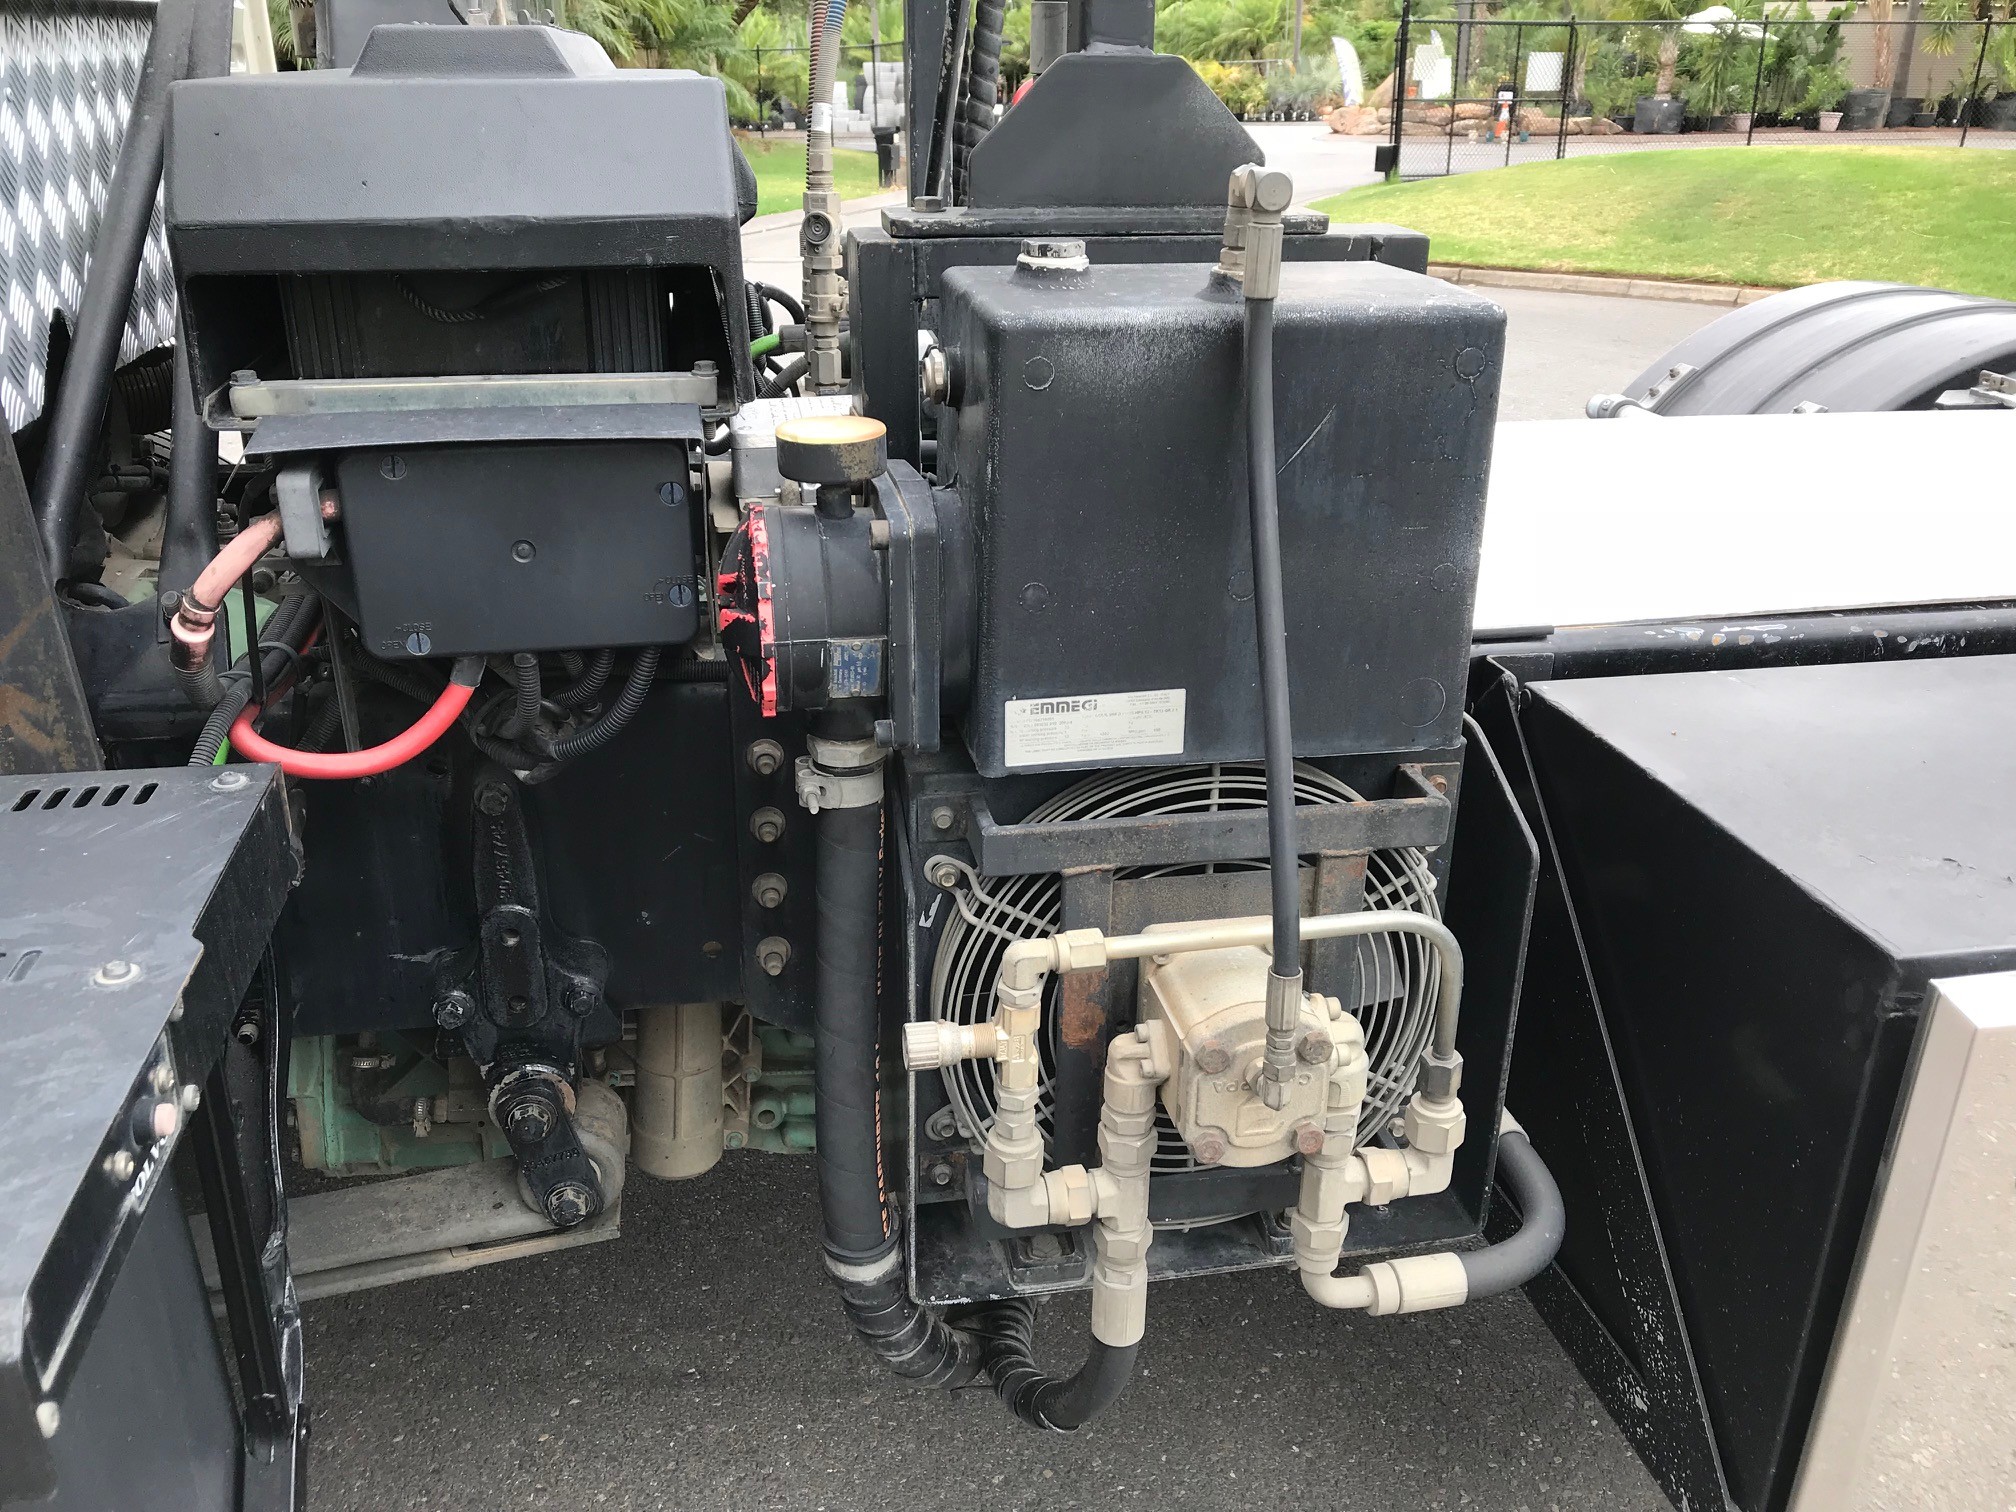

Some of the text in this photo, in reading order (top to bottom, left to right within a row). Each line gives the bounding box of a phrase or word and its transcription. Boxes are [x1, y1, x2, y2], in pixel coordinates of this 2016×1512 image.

[403, 621, 432, 632] CLOSE
[1212, 1073, 1312, 1095] CPPA
[131, 1136, 168, 1197] OLV
